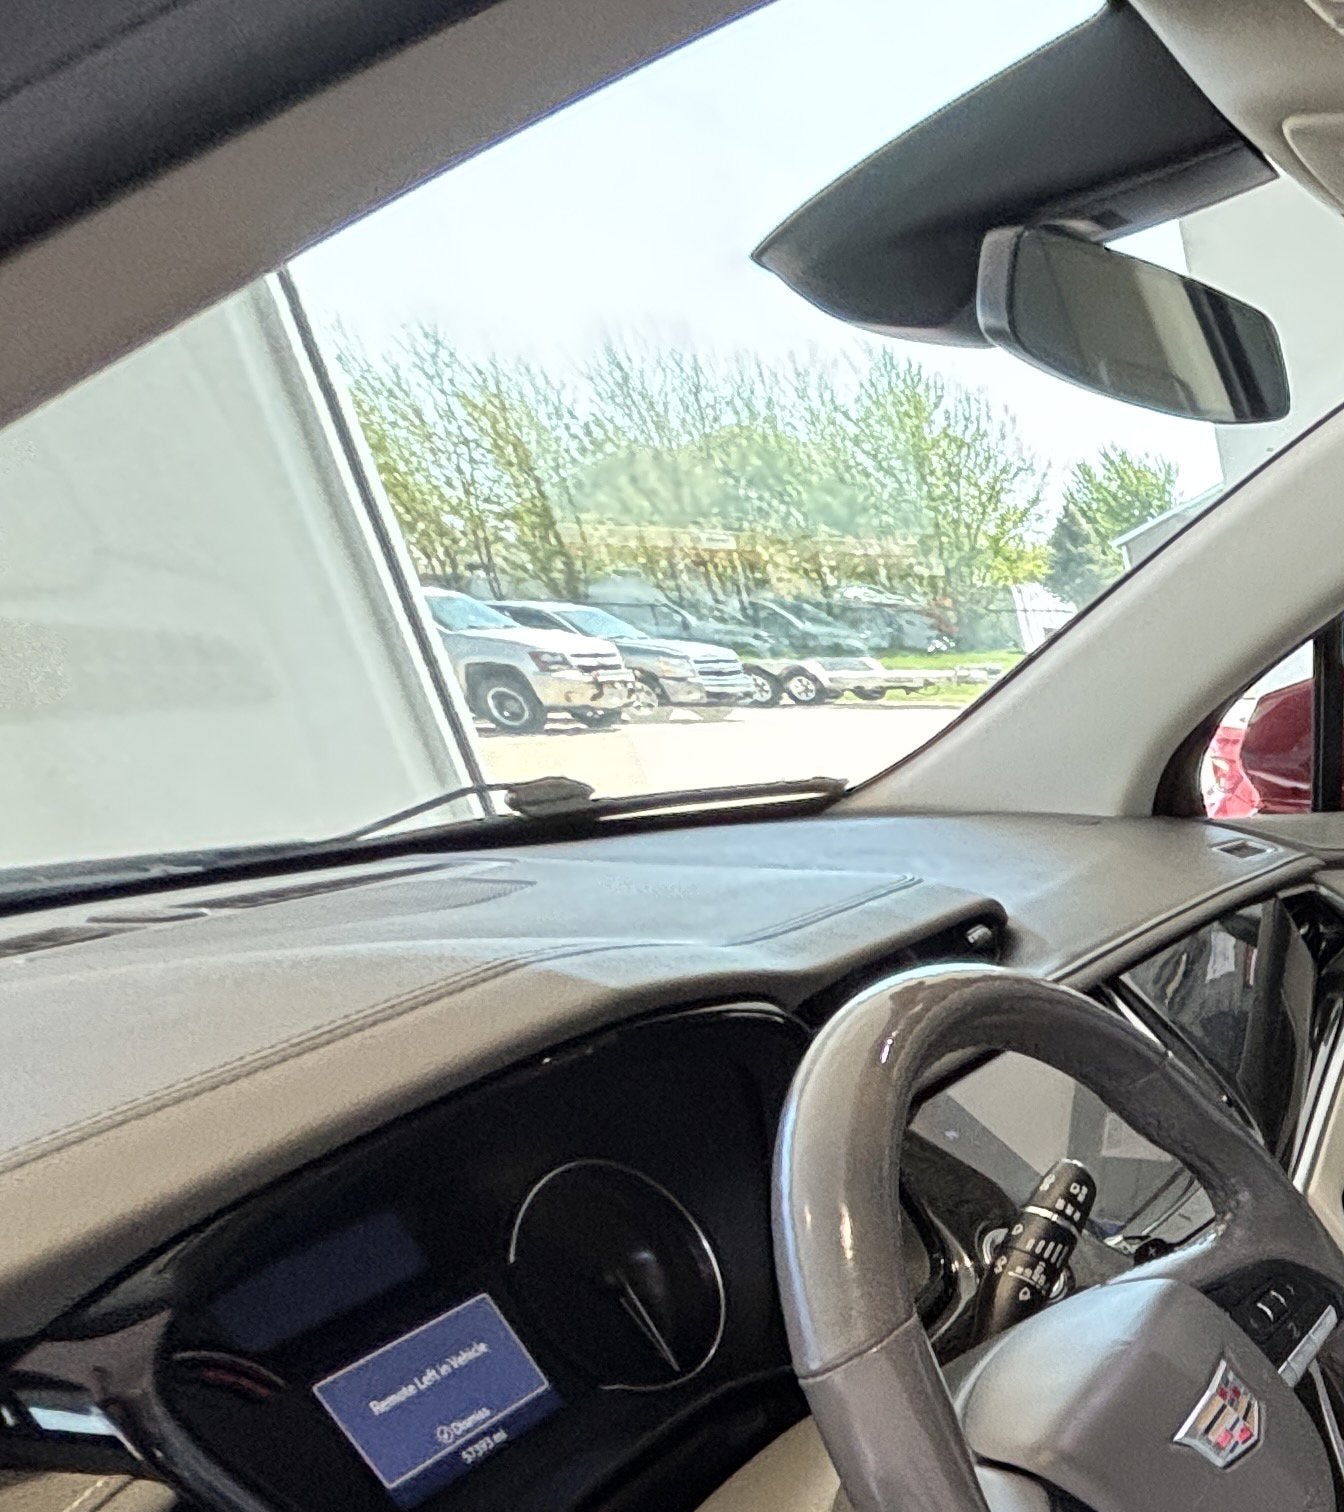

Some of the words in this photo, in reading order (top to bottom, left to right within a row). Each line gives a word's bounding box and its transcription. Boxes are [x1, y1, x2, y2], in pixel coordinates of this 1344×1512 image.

[369, 1383, 418, 1416] Remote
[413, 1368, 440, 1390] Left
[446, 1342, 490, 1369] Vehicle
